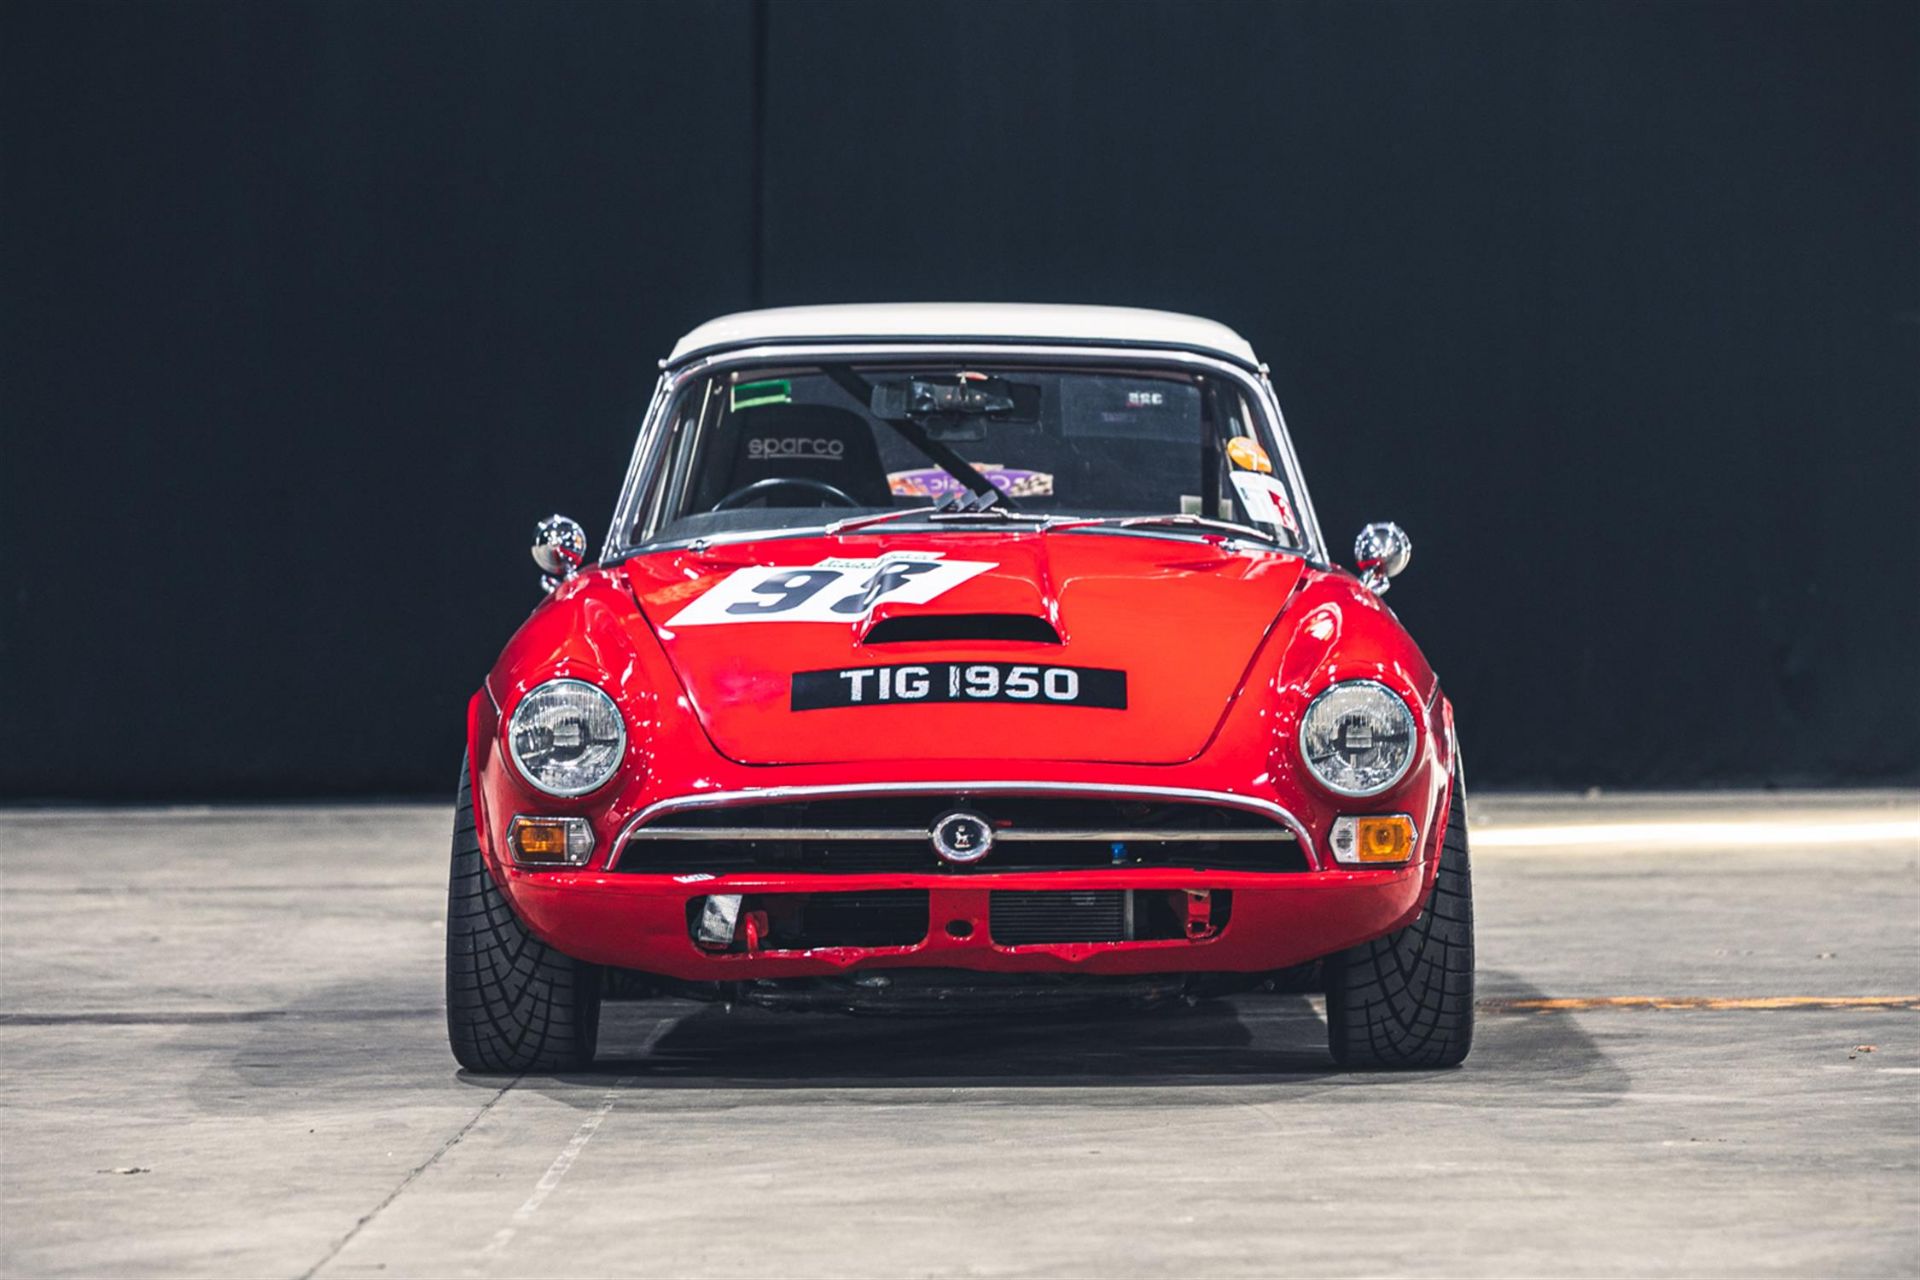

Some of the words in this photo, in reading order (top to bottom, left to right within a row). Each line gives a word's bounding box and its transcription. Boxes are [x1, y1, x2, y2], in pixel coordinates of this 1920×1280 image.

[748, 438, 844, 459] sparco
[840, 666, 930, 702] TIG
[949, 664, 1080, 701] 1950
